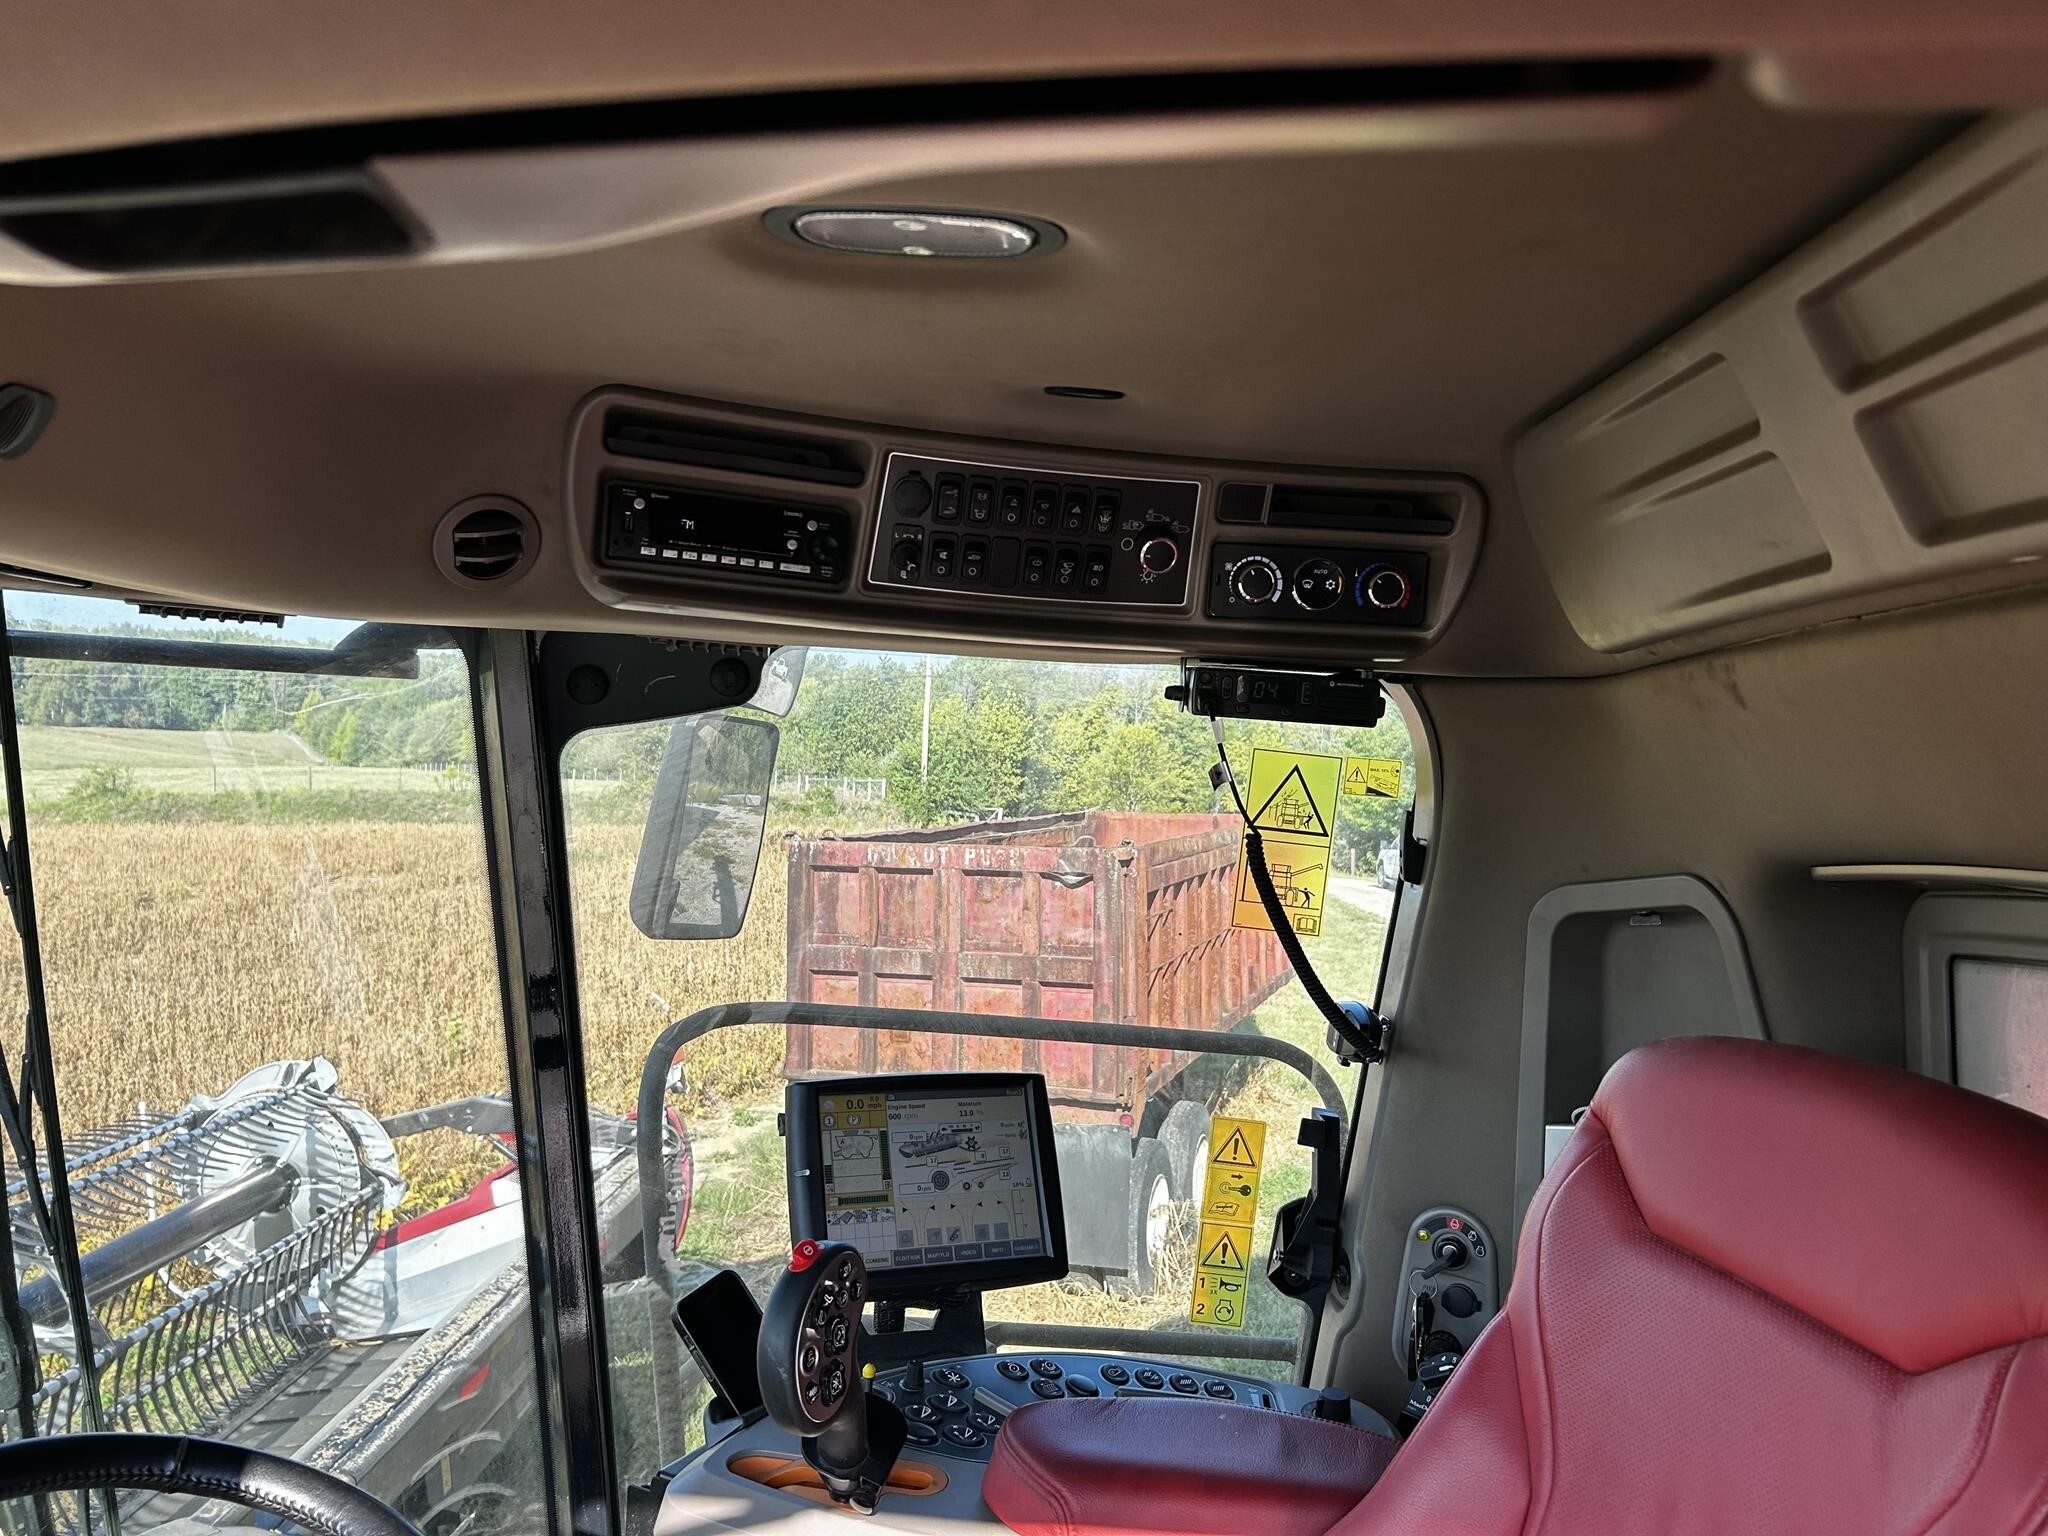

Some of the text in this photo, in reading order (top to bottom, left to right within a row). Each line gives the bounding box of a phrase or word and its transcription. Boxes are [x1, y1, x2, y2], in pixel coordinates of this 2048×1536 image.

[1253, 681, 1279, 698] 04
[846, 1098, 864, 1110] 0.0
[888, 1104, 907, 1112] Engine
[865, 1257, 889, 1265] COMBINE
[1199, 1277, 1206, 1289] 1
[1196, 1303, 1205, 1315] 2
[1409, 1399, 1429, 1411] MacD
